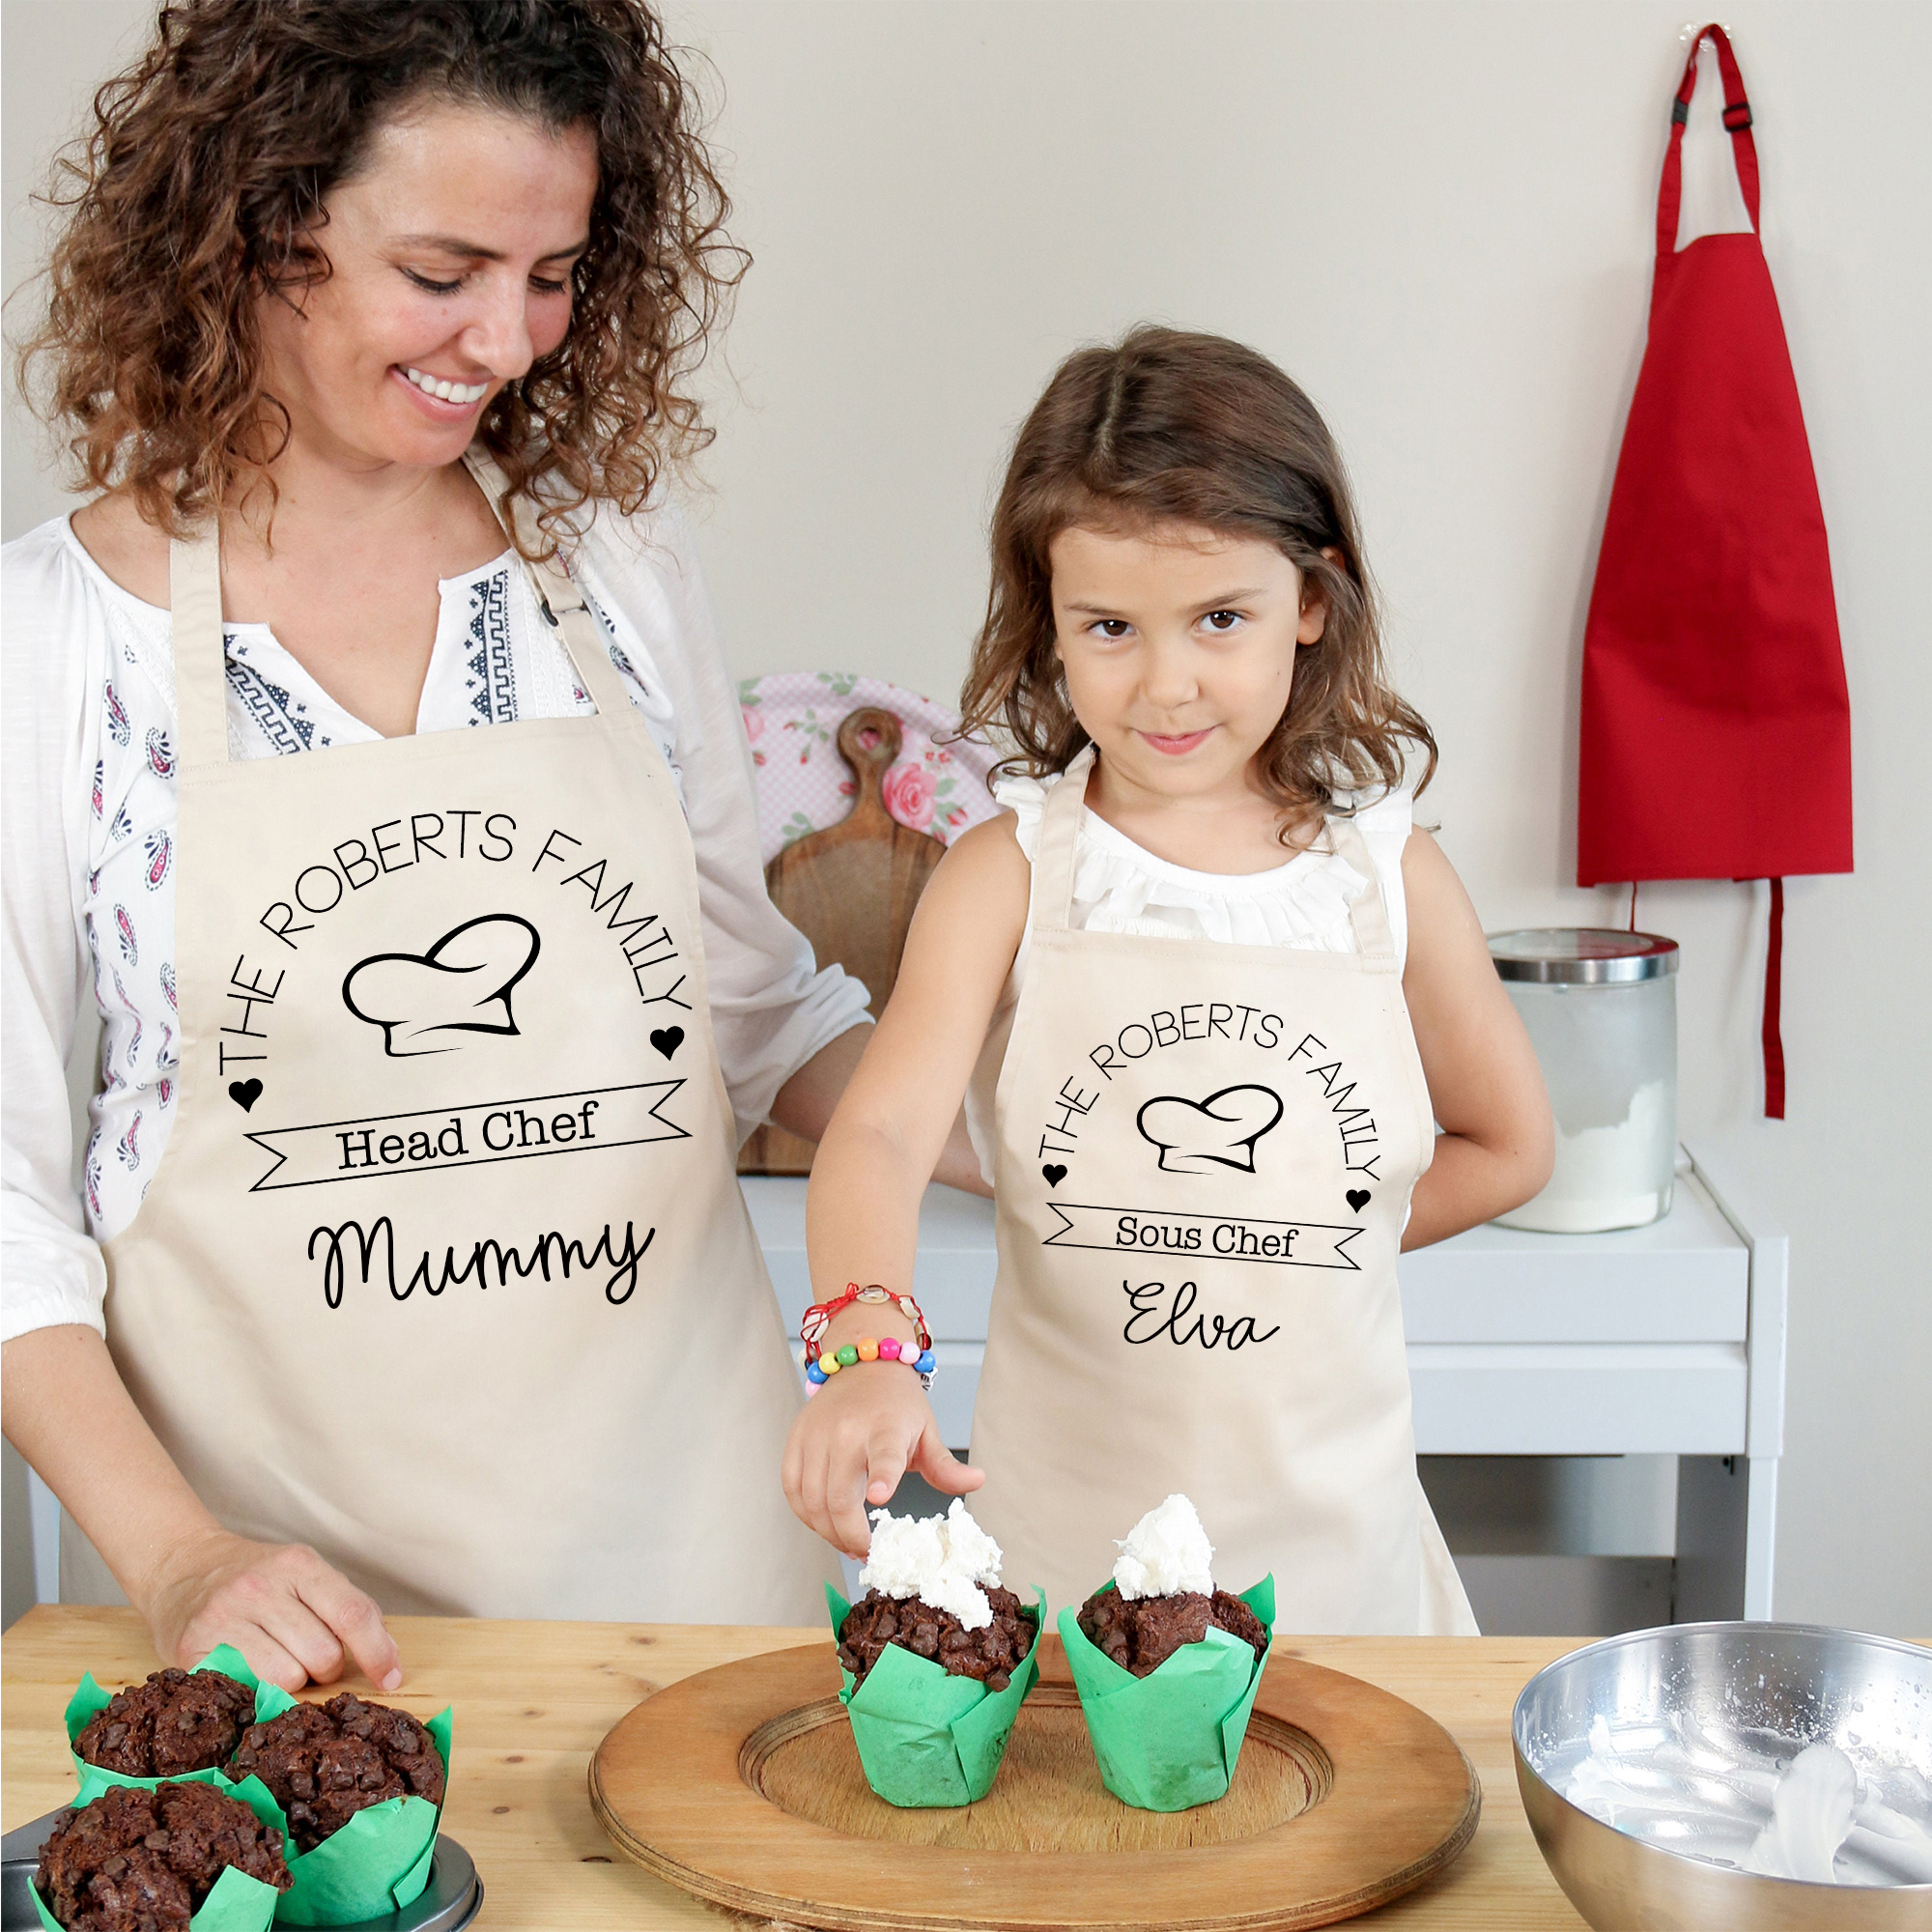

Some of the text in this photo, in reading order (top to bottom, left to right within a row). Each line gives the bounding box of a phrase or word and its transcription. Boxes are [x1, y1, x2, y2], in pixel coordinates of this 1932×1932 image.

[219, 810, 693, 1076] THE ROBERTS FAMILY
[1037, 1003, 1381, 1181] THE ROBERTS FAMILY
[334, 1099, 600, 1170] Head Chef
[307, 1215, 656, 1310] Mummy
[1116, 1216, 1300, 1258] Sous Chef
[1122, 1279, 1281, 1350] Elva
